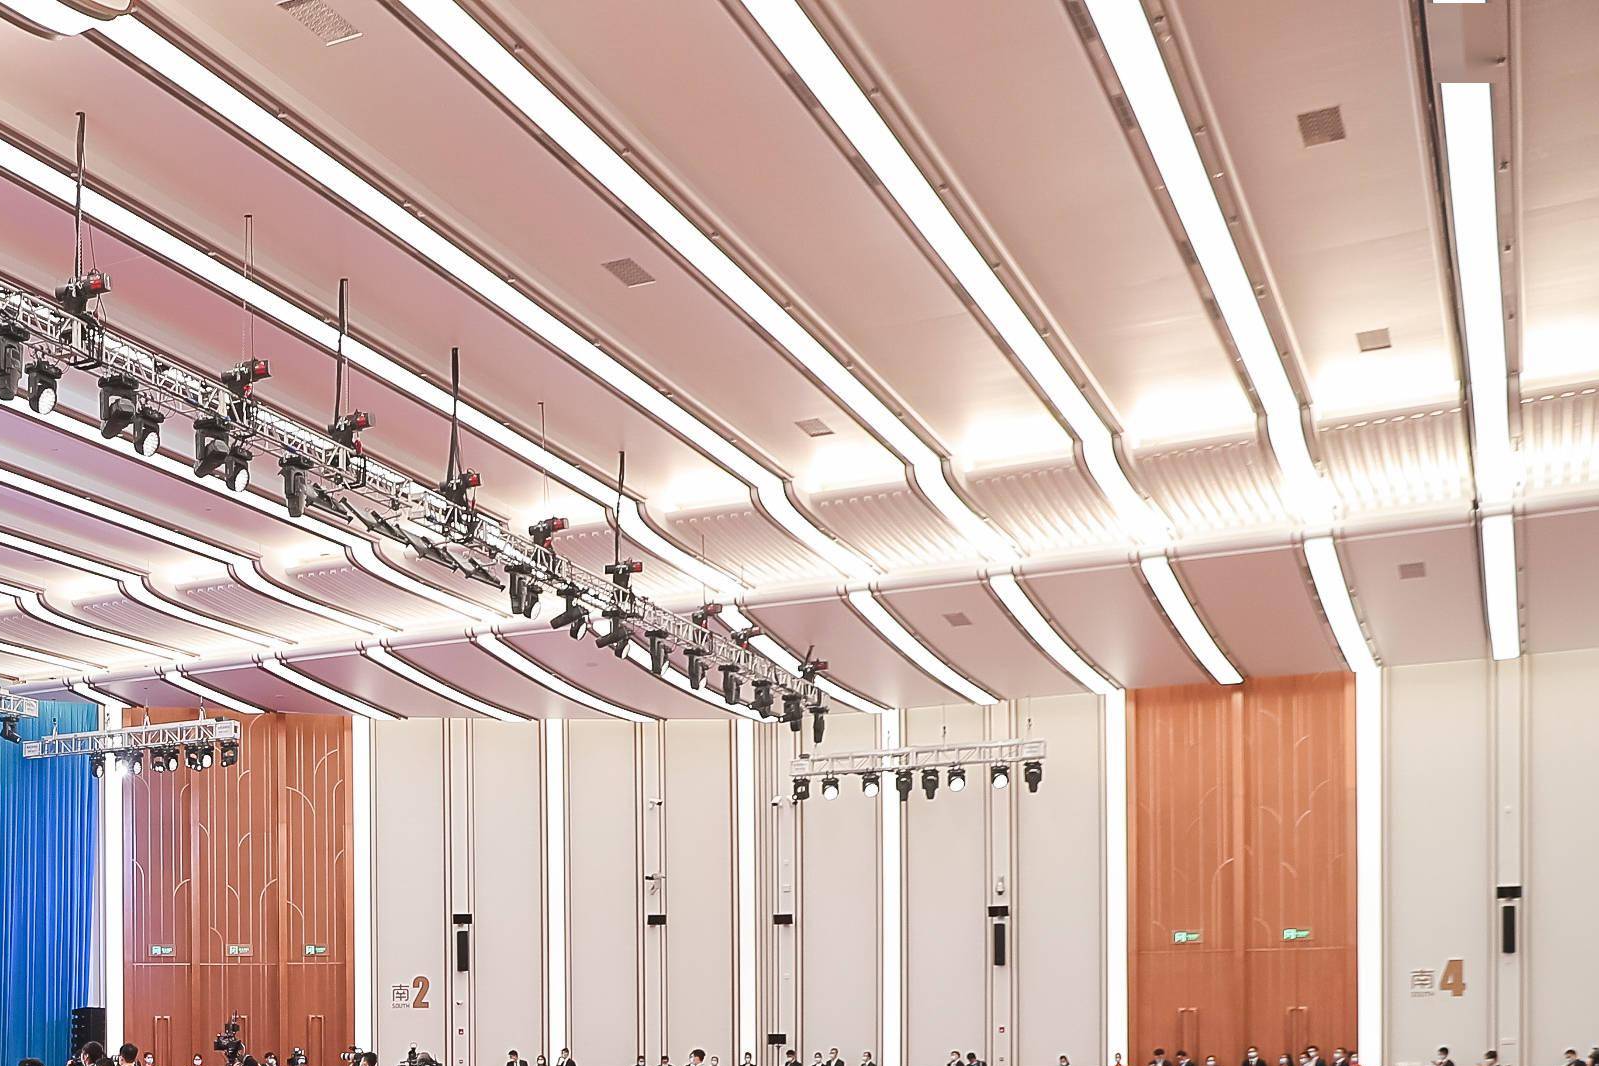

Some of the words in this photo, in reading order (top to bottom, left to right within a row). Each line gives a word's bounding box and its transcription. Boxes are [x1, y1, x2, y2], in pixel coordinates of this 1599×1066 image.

[392, 983, 410, 1002] 南
[412, 975, 430, 1009] 2
[1439, 959, 1466, 997] 4
